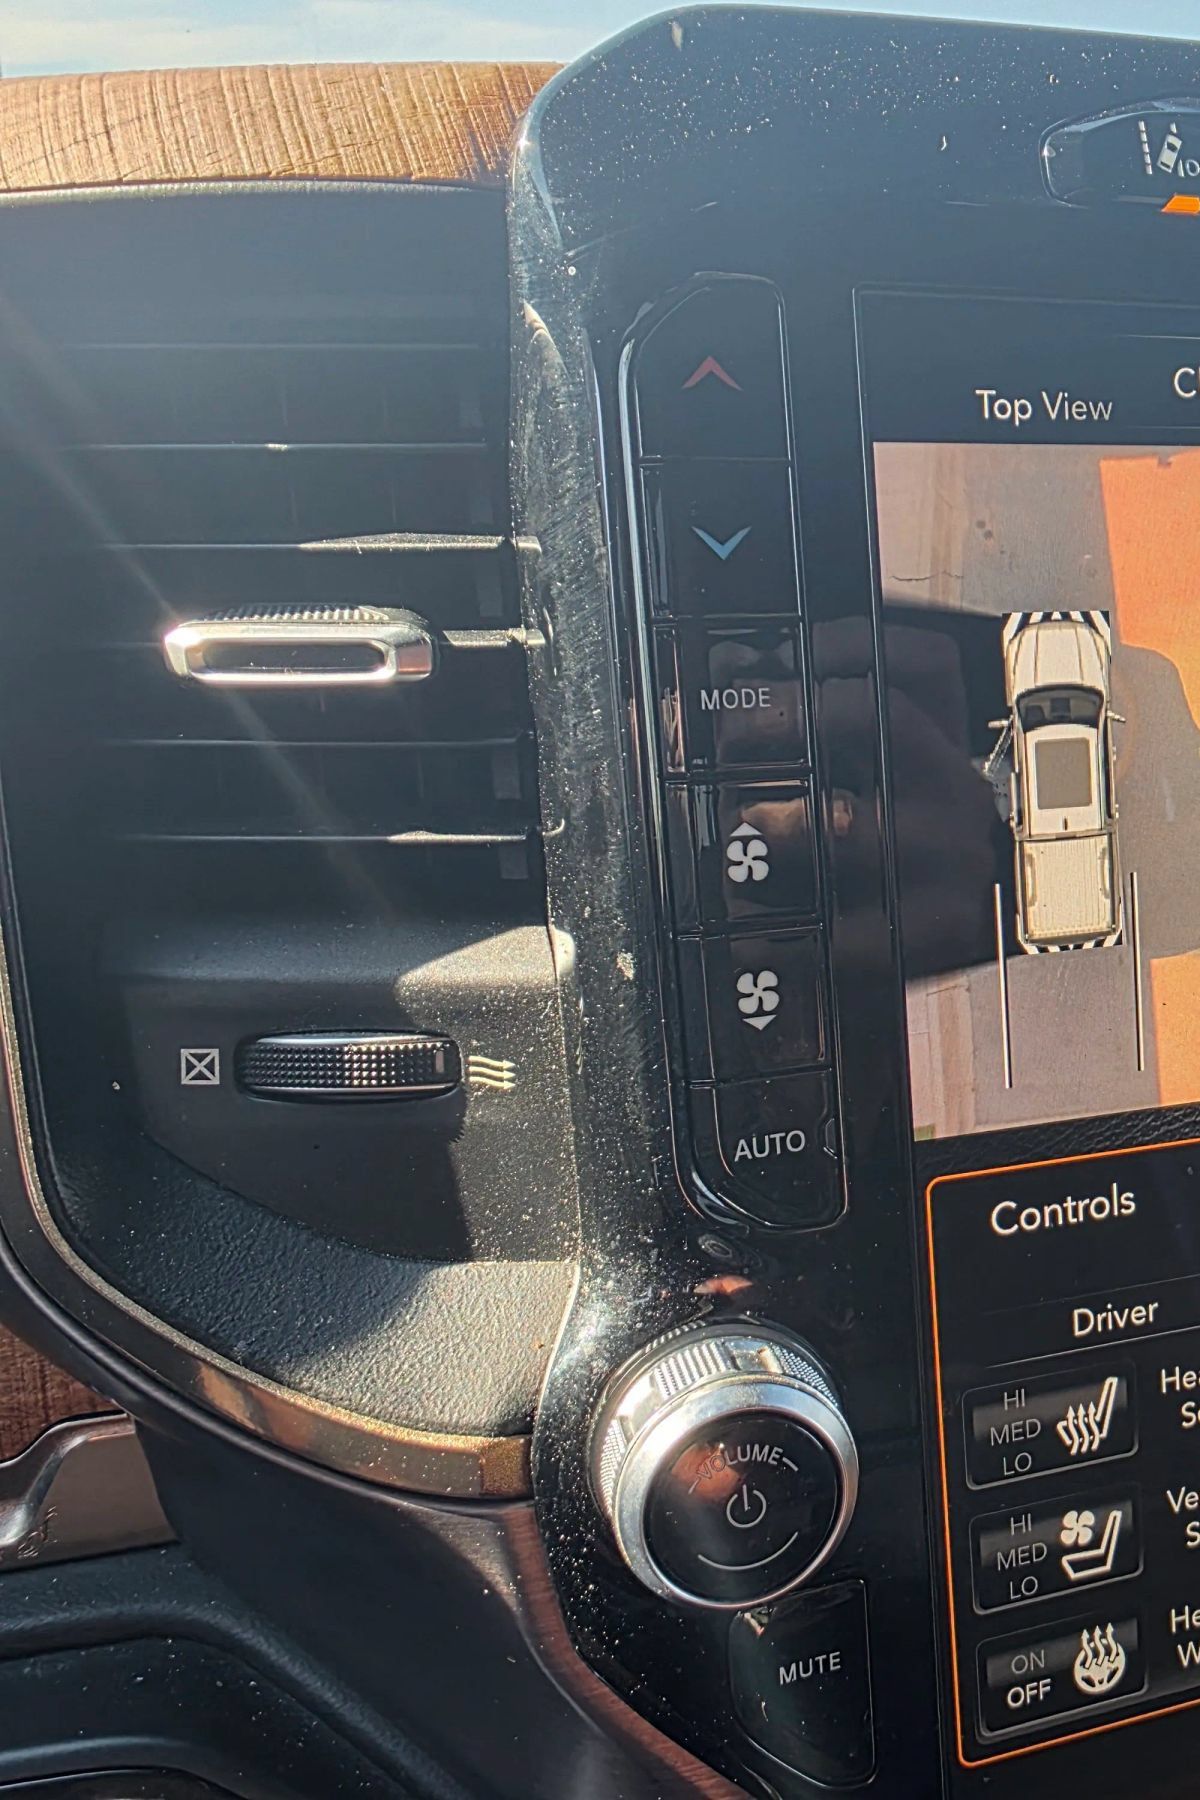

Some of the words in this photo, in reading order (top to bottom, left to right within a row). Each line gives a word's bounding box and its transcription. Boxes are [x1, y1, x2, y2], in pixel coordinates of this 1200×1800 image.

[975, 389, 1032, 427] Top
[1041, 391, 1113, 421] View
[700, 687, 772, 711] MODE
[733, 1128, 807, 1162] AUTO
[990, 1182, 1137, 1236] Controls
[1072, 1301, 1159, 1338] Driver
[1003, 1388, 1026, 1411] HI
[990, 1418, 1042, 1447] MED
[695, 1443, 784, 1481] VOLUME
[1003, 1452, 1032, 1476] LO
[1010, 1512, 1032, 1536] HI
[996, 1542, 1048, 1571] MED
[1009, 1575, 1039, 1600] LO
[778, 1651, 842, 1686] MUTE
[1010, 1650, 1046, 1675] ON
[1007, 1678, 1052, 1708] OFF
